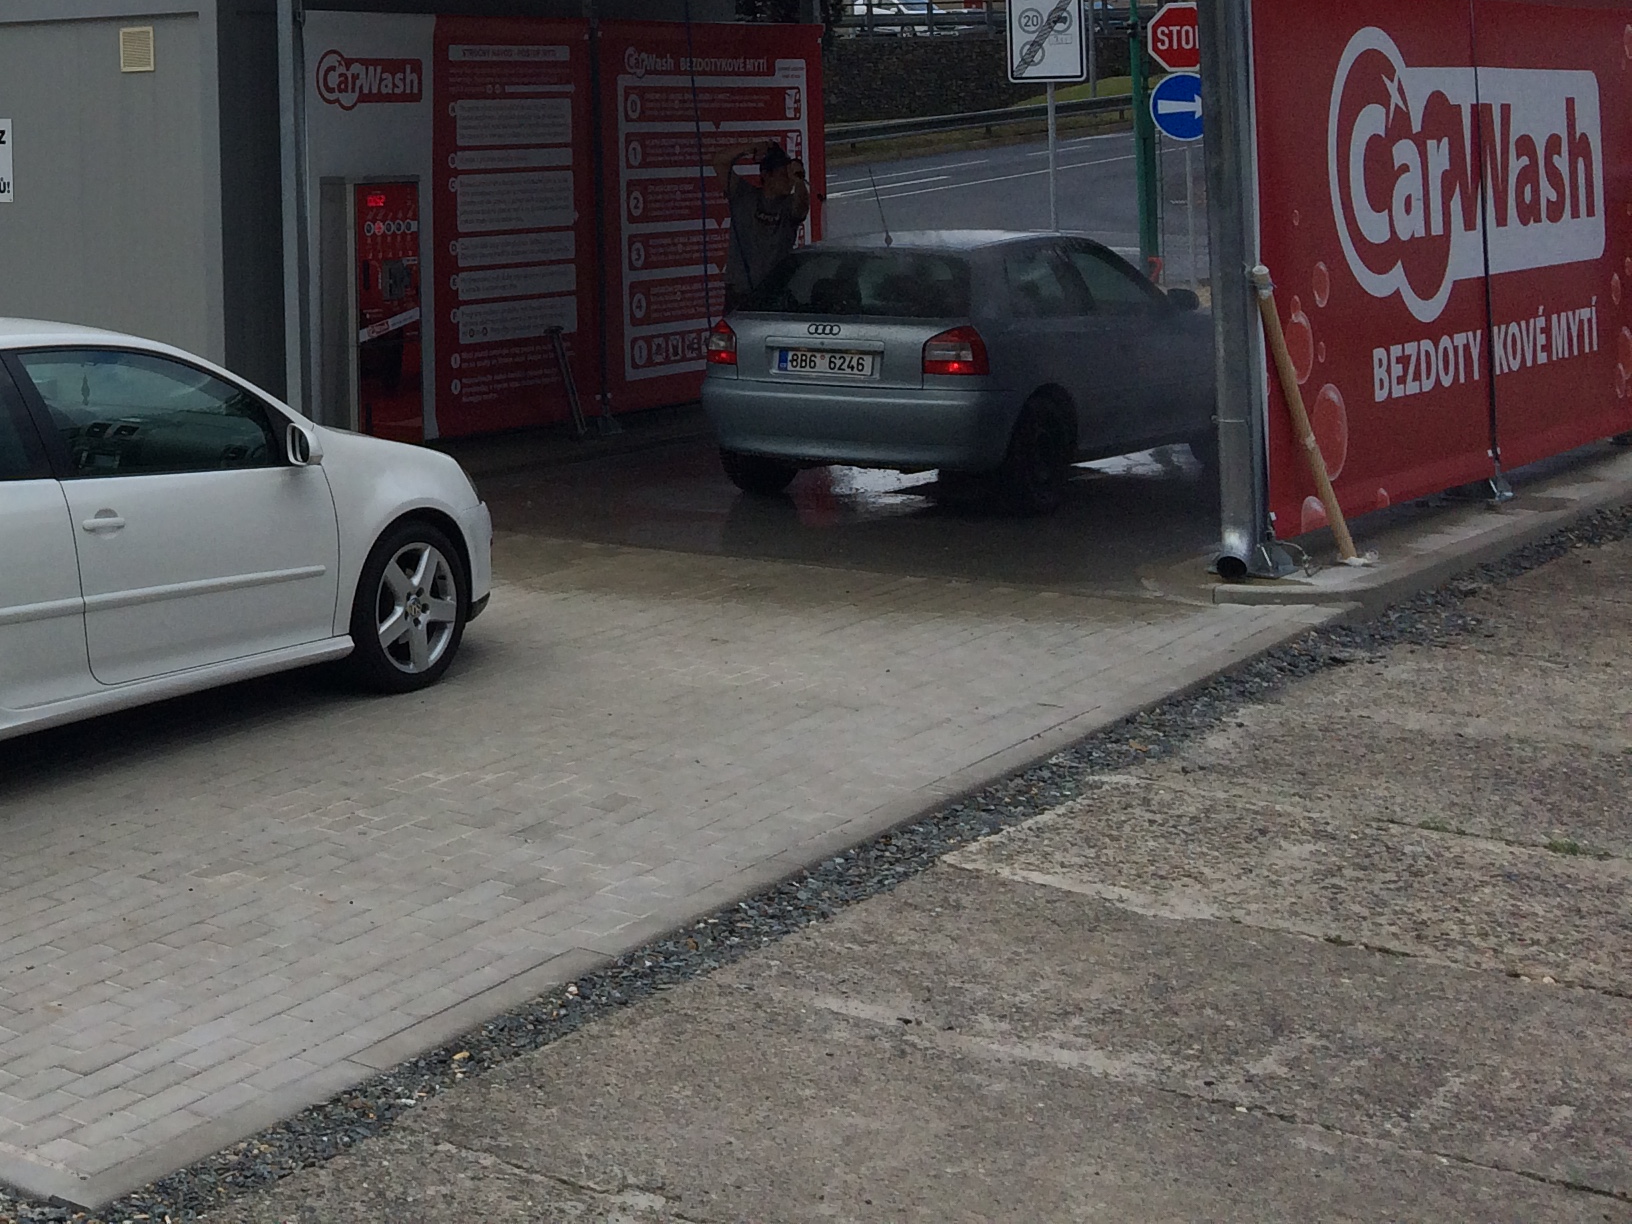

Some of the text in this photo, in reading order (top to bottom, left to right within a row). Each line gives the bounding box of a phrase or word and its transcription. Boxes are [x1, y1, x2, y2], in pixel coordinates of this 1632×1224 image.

[1023, 14, 1039, 27] 20
[322, 64, 418, 94] CarWash
[1349, 95, 1597, 245] CarWash
[1551, 295, 1599, 361] MYTÍ
[790, 353, 866, 372] 8B6 6246
